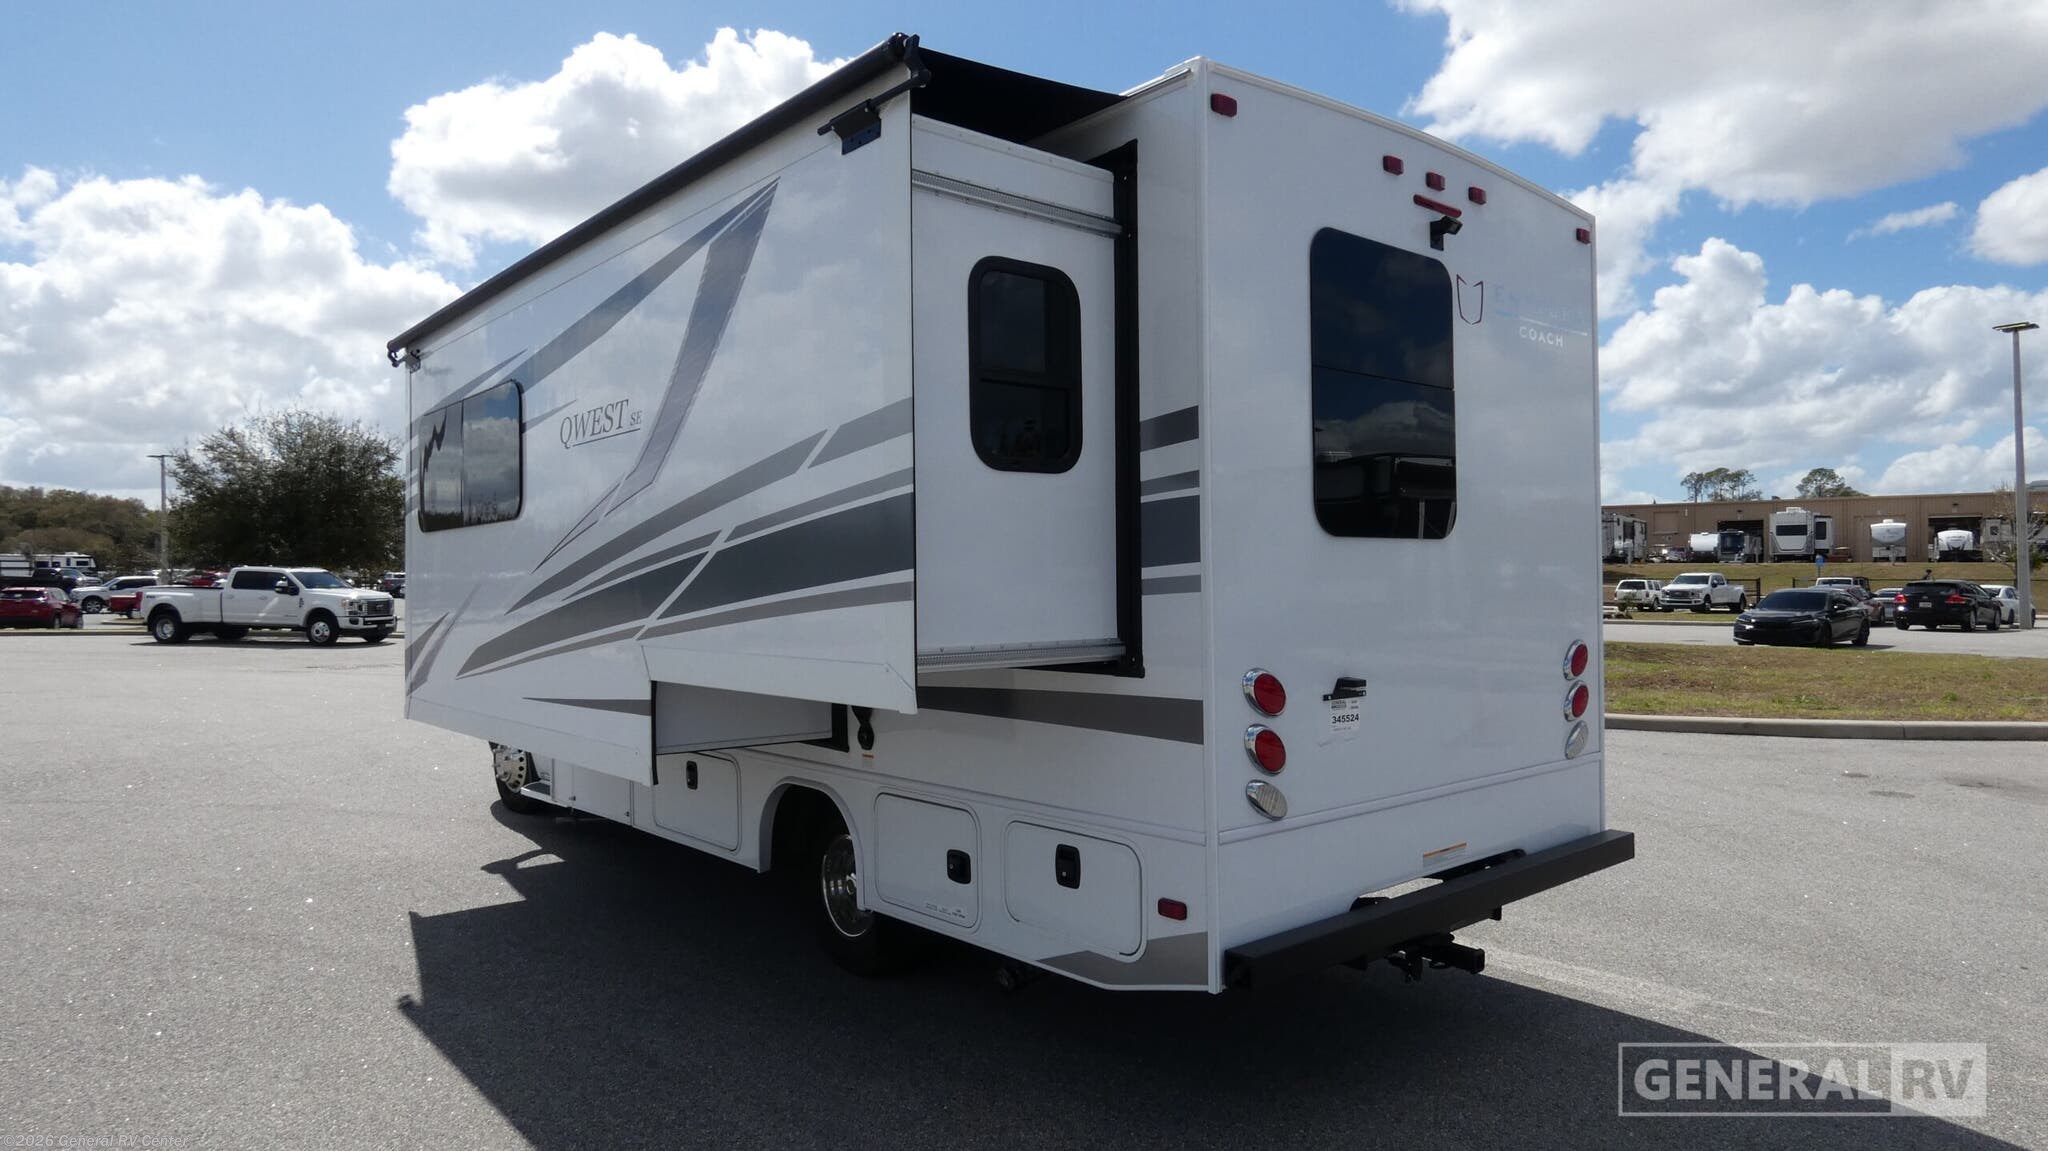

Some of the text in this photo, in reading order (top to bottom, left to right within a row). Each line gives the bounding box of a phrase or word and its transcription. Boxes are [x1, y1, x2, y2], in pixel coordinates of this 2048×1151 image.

[1519, 326, 1564, 347] COACH
[560, 399, 643, 450] QWEST SE
[1331, 713, 1360, 725] 345524
